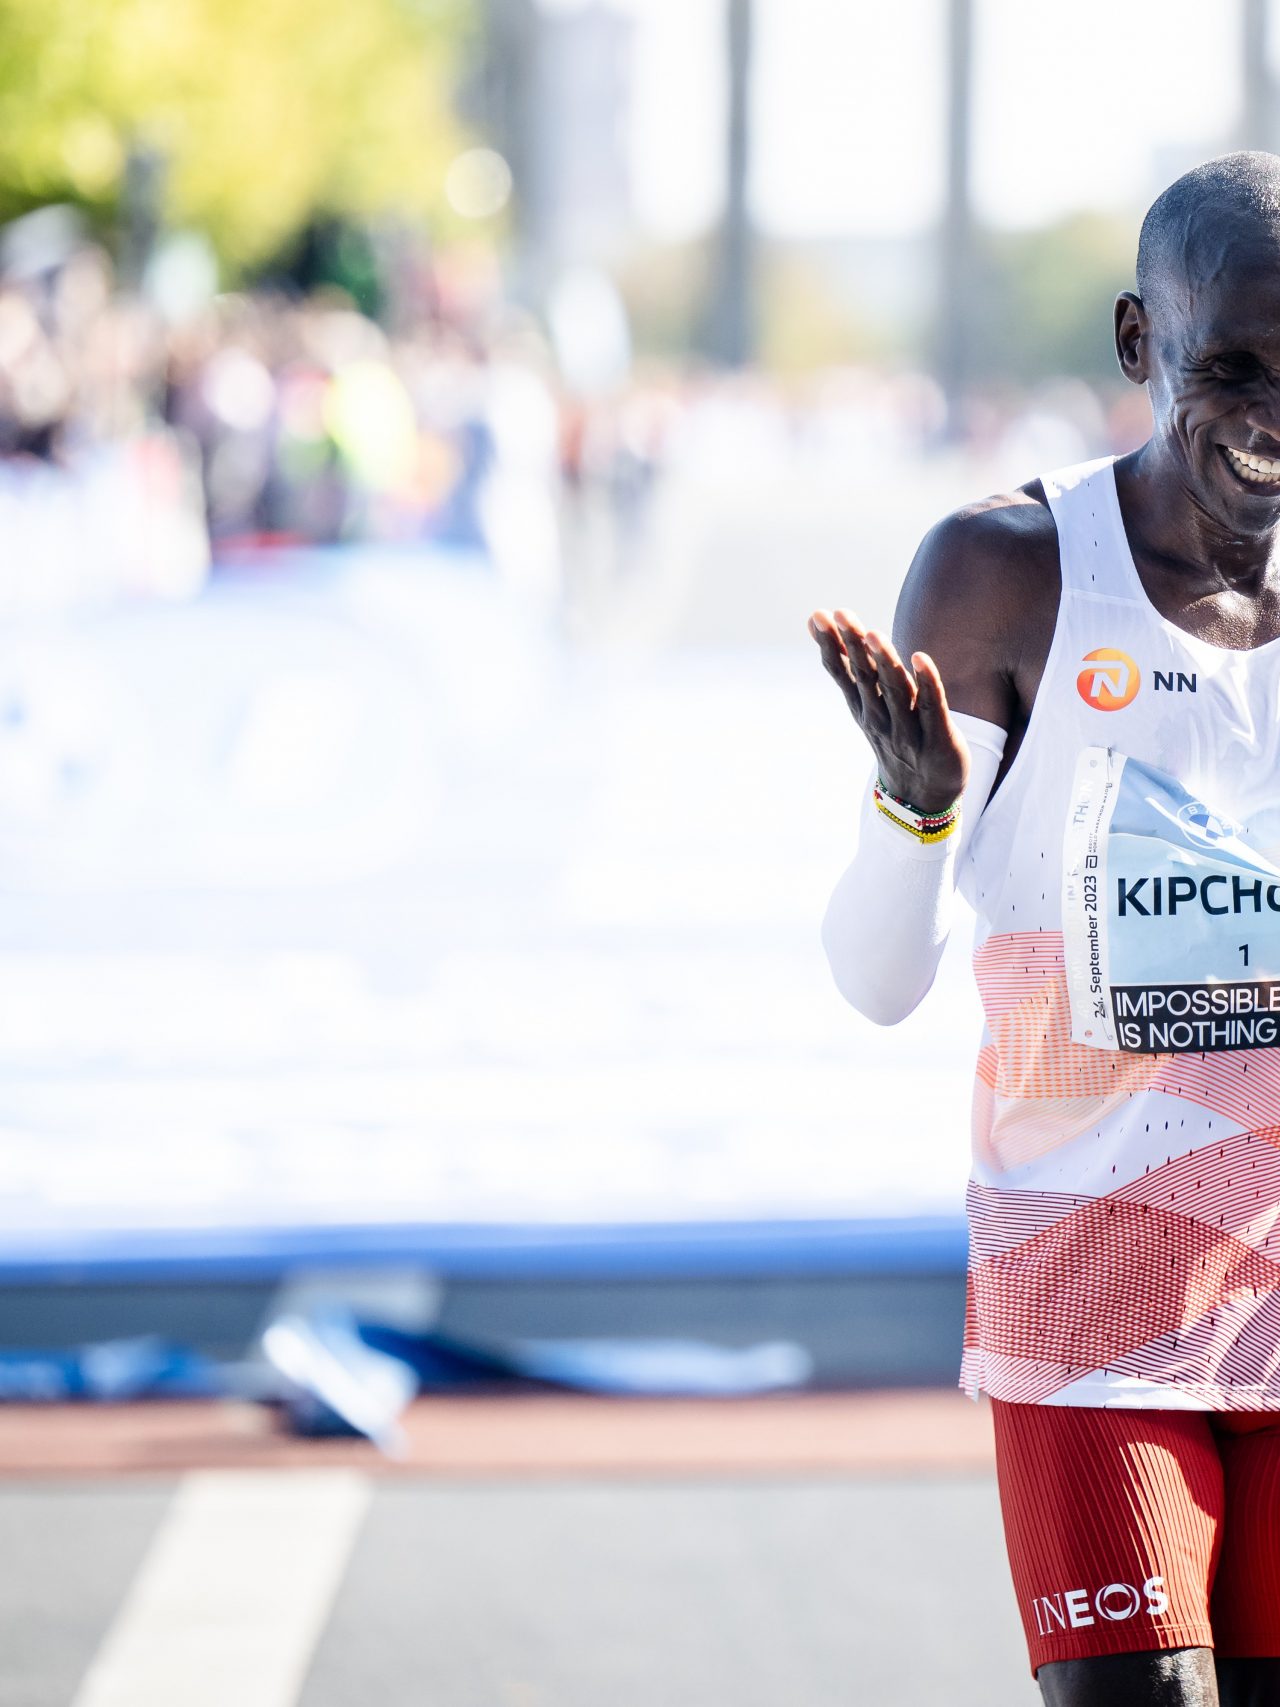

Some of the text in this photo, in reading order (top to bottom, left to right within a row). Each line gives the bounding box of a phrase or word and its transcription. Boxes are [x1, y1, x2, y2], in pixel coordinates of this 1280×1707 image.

[1153, 671, 1197, 693] NN
[1083, 875, 1097, 912] 2023
[1087, 915, 1102, 994] September
[1238, 944, 1249, 967] 1
[1119, 1017, 1278, 1048] IS NOTHING
[1033, 1575, 1170, 1637] INEOS
